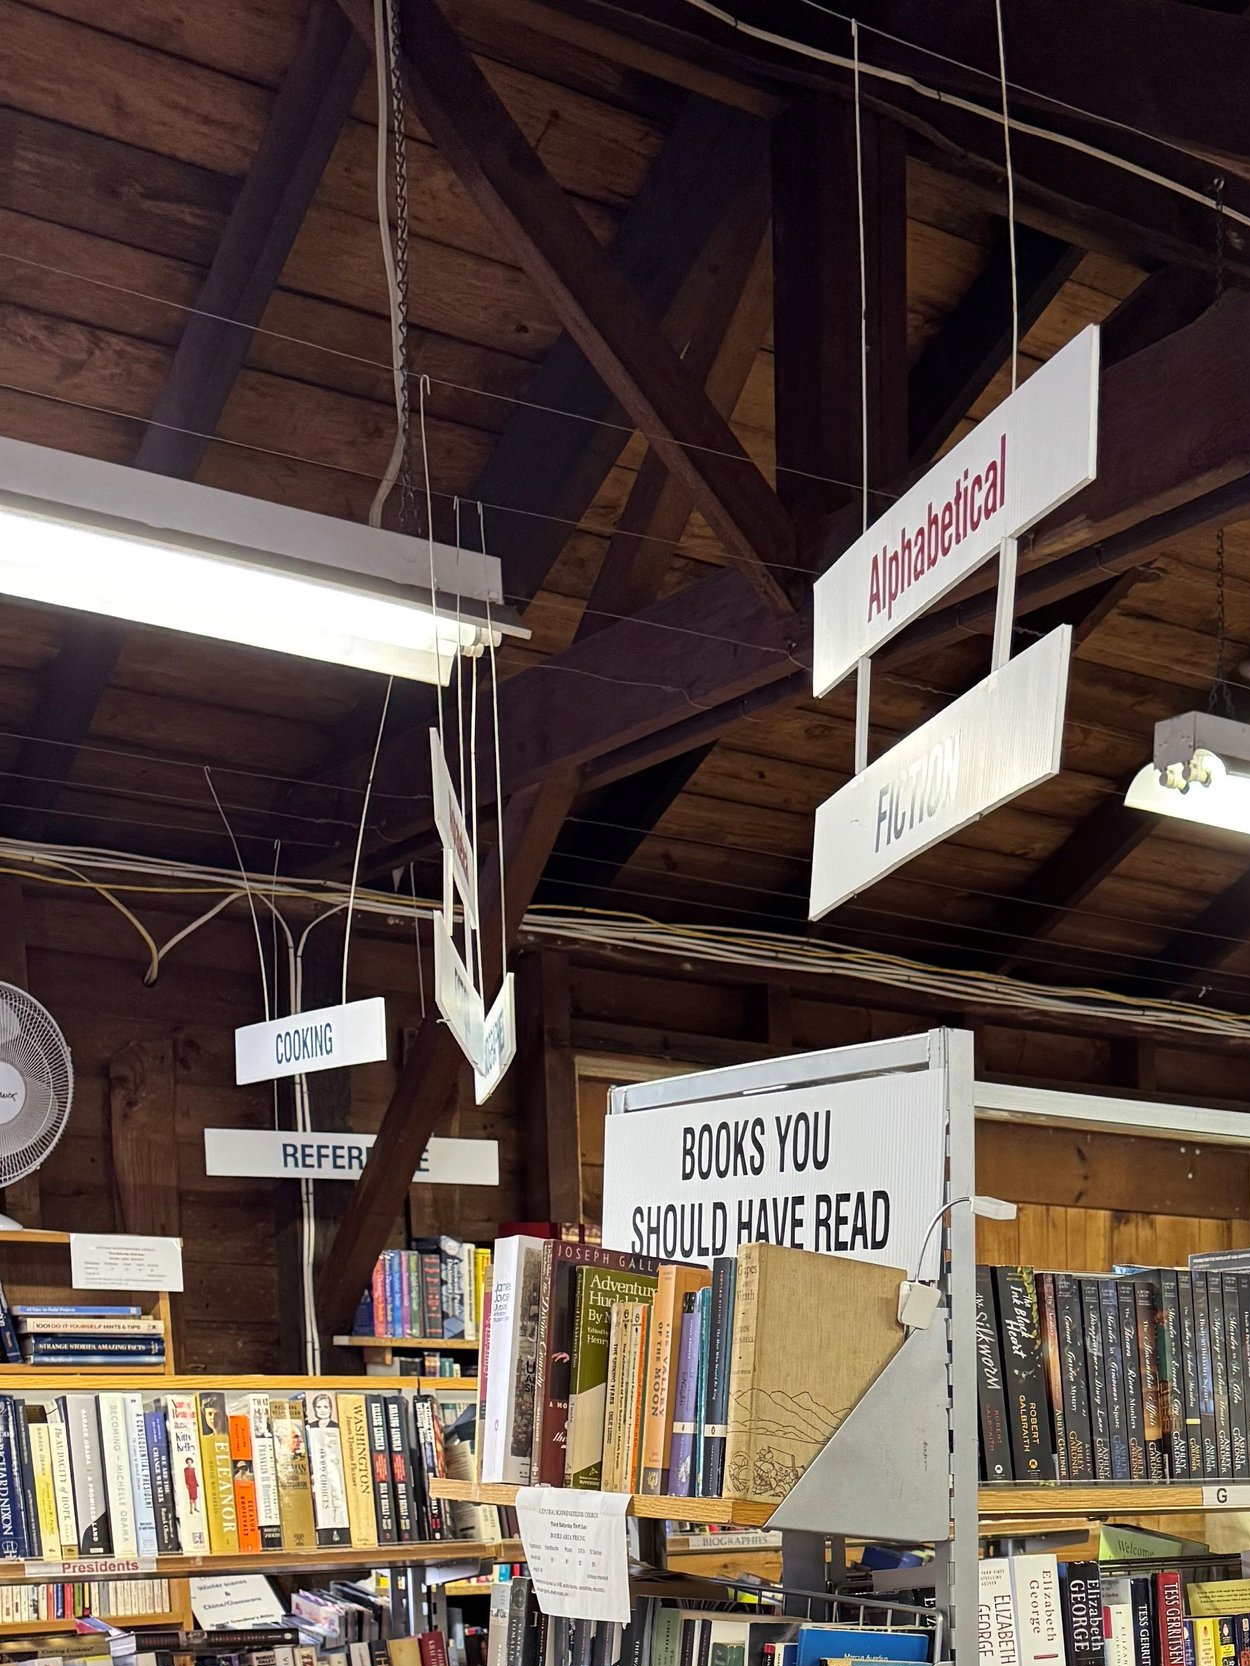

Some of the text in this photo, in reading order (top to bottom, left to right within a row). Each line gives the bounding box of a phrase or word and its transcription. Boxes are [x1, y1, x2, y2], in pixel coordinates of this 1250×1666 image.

[868, 435, 1007, 623] Alphabetical
[875, 729, 962, 854] FICTION
[276, 1023, 333, 1064] COOKING
[682, 1110, 831, 1181] BOOKS YOU
[632, 1190, 890, 1258] SHOULD HAVE READ
[352, 1404, 371, 1494] WASHINGTON
[1018, 1395, 1031, 1452] GALBRAITH
[1029, 1402, 1040, 1444] ROBERT
[214, 1441, 236, 1534] ELEANOR
[1216, 1488, 1227, 1504] G
[62, 1560, 139, 1573] Presidents
[703, 1535, 768, 1547] BIOGRAPHIES
[1029, 1580, 1042, 1635] George
[1042, 1570, 1055, 1642] Elizabeth
